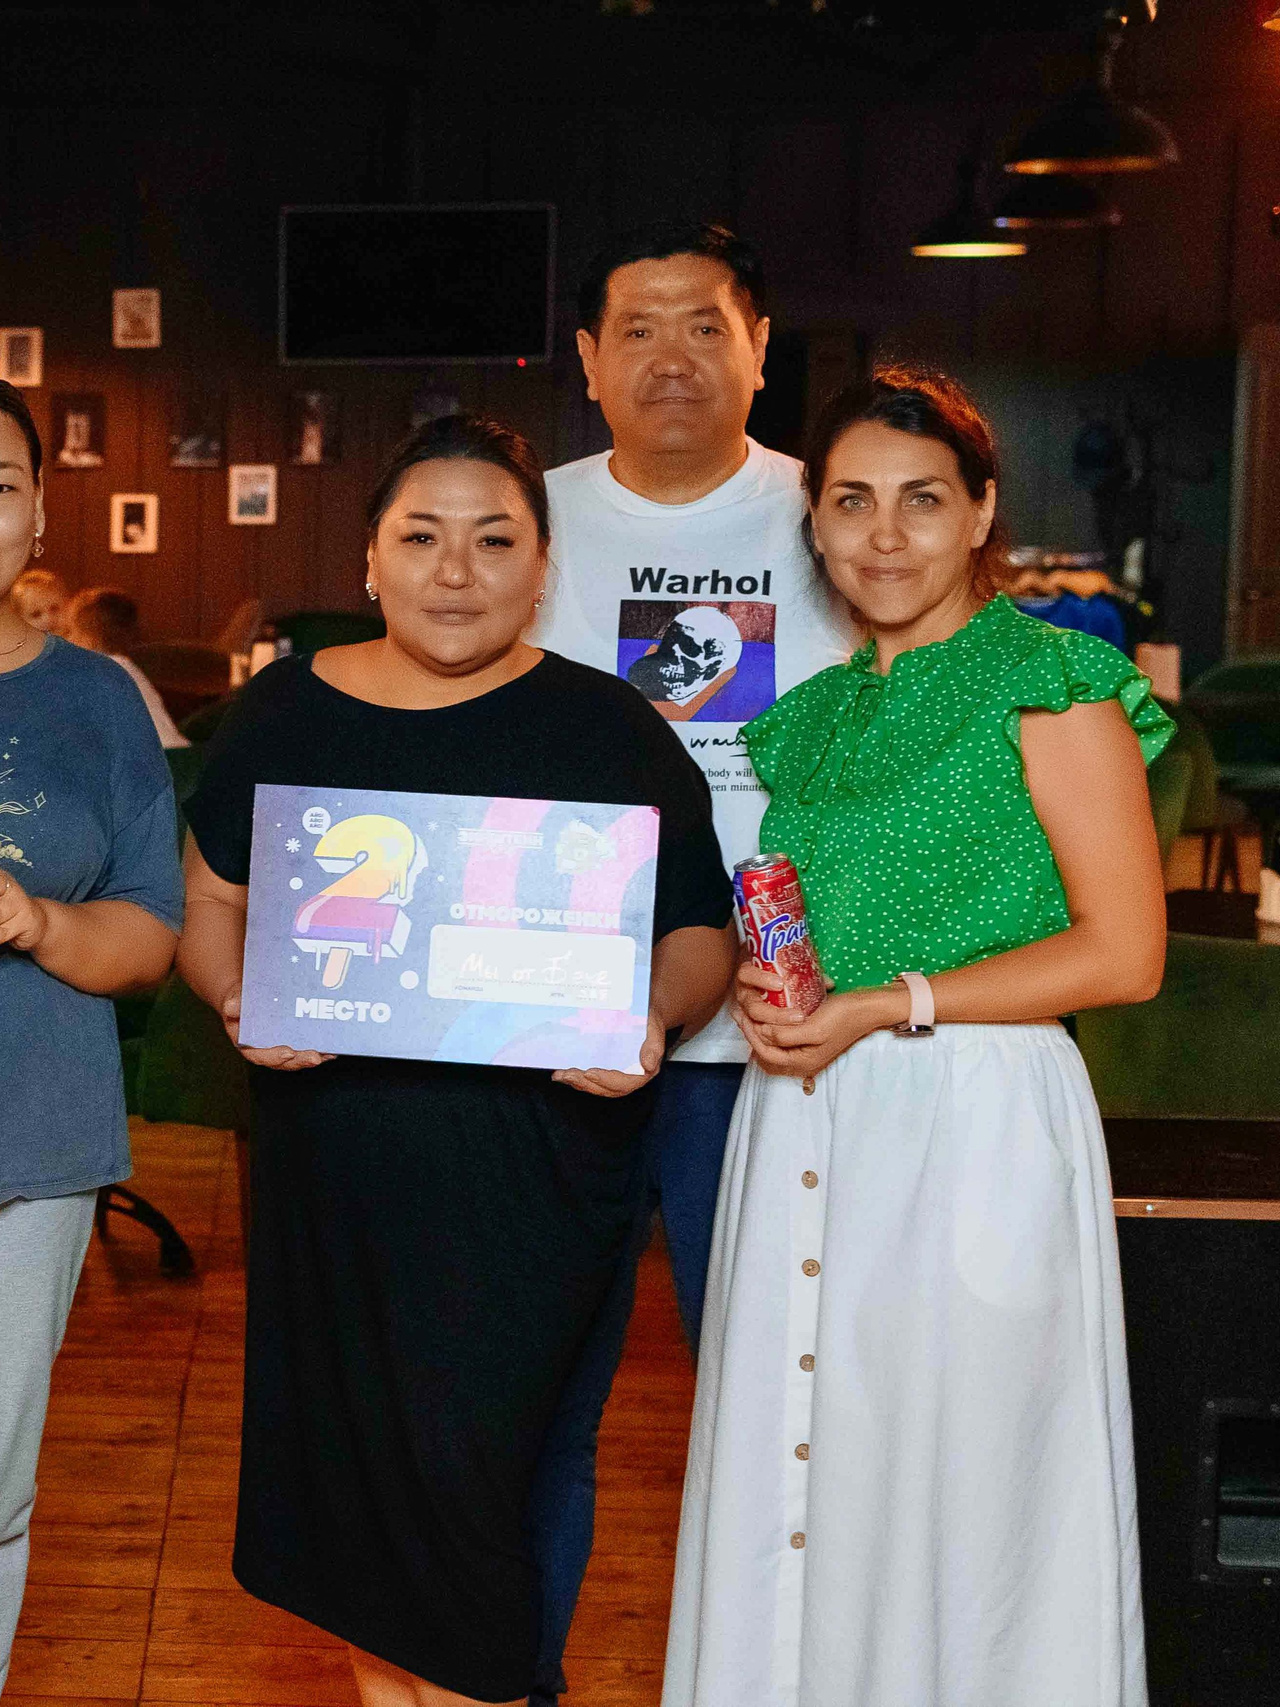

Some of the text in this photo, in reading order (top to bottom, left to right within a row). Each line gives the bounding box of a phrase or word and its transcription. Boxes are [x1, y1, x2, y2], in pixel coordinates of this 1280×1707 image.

[629, 567, 772, 596] Warhol
[735, 767, 752, 777] will
[291, 813, 426, 958] 2
[295, 998, 391, 1023] МЕСТО
